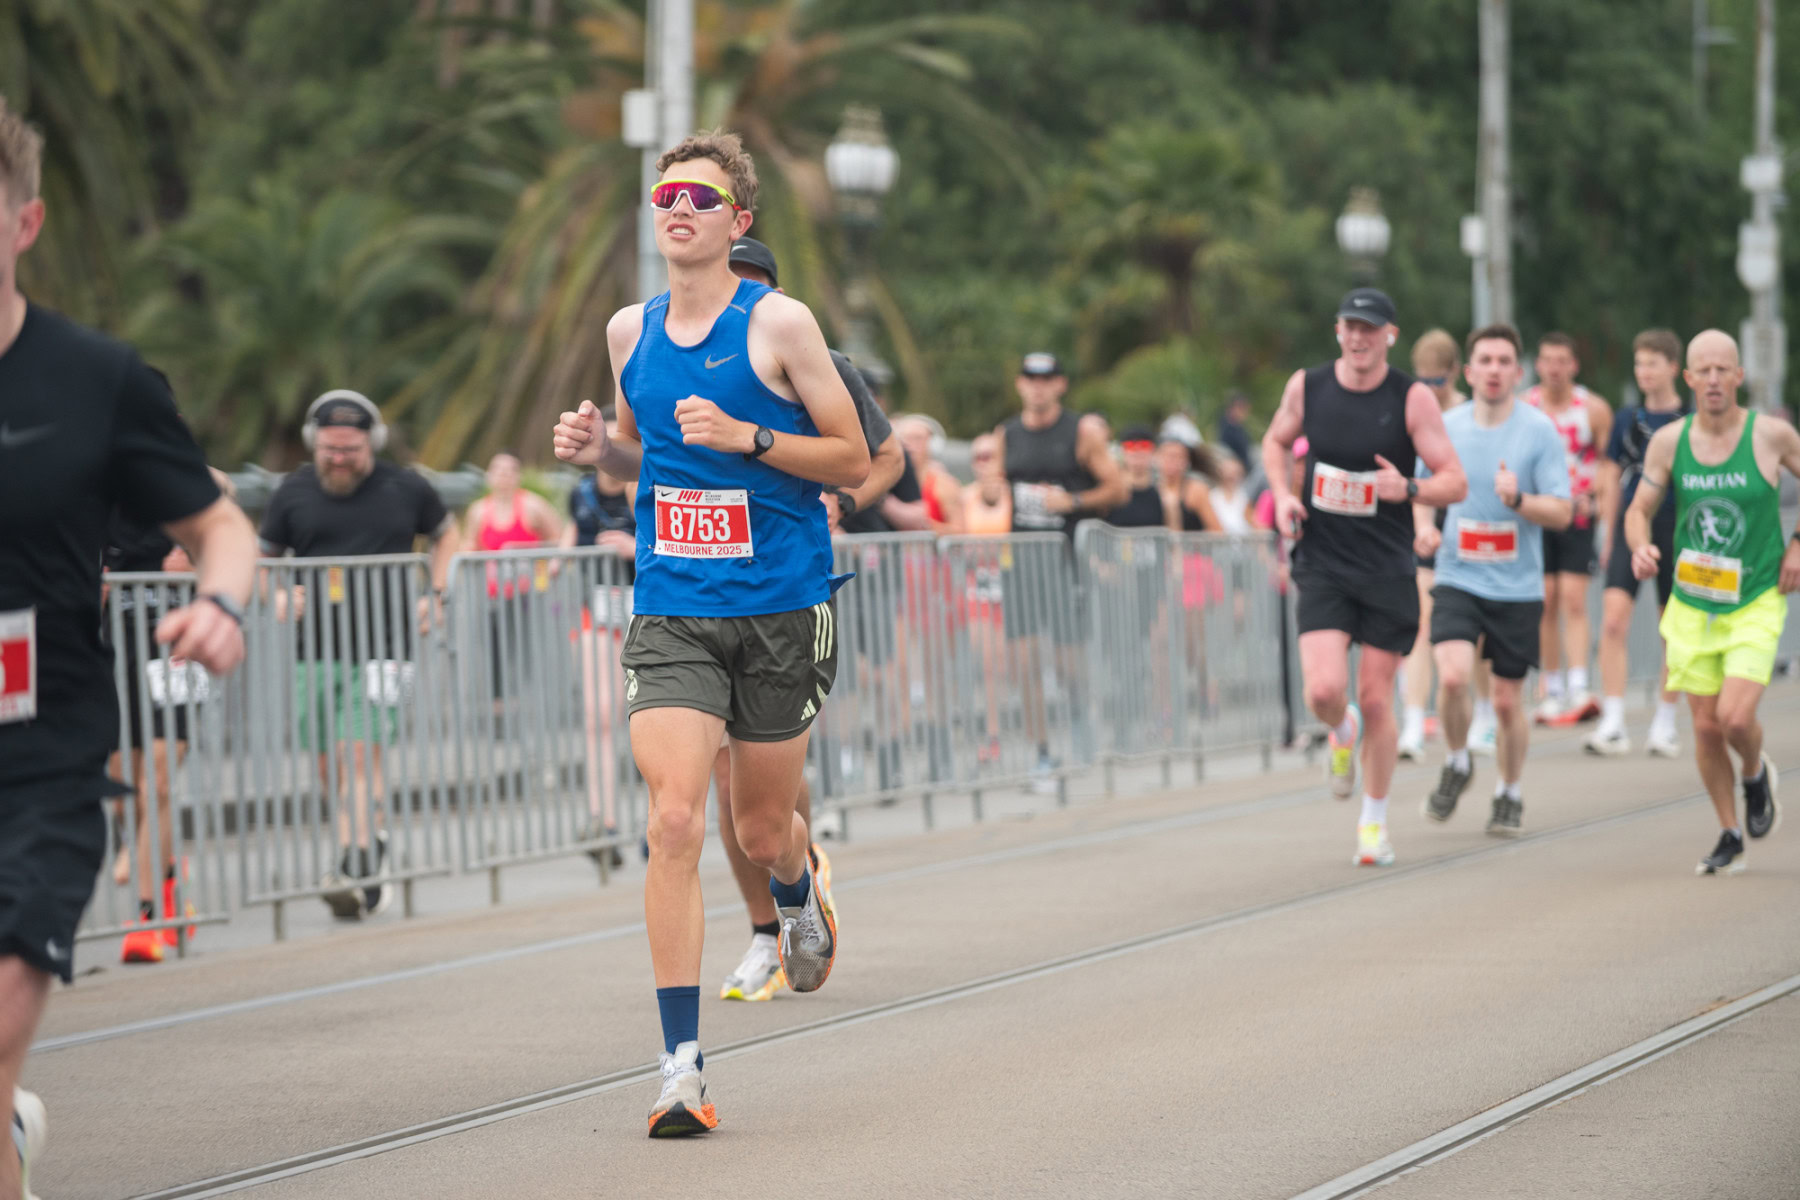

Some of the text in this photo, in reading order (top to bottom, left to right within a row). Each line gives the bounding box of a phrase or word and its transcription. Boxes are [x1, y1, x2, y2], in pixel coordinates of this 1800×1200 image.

[1681, 472, 1747, 490] SPARTAN
[669, 506, 731, 542] 8753
[664, 543, 742, 556] MELBOURNE 2025
